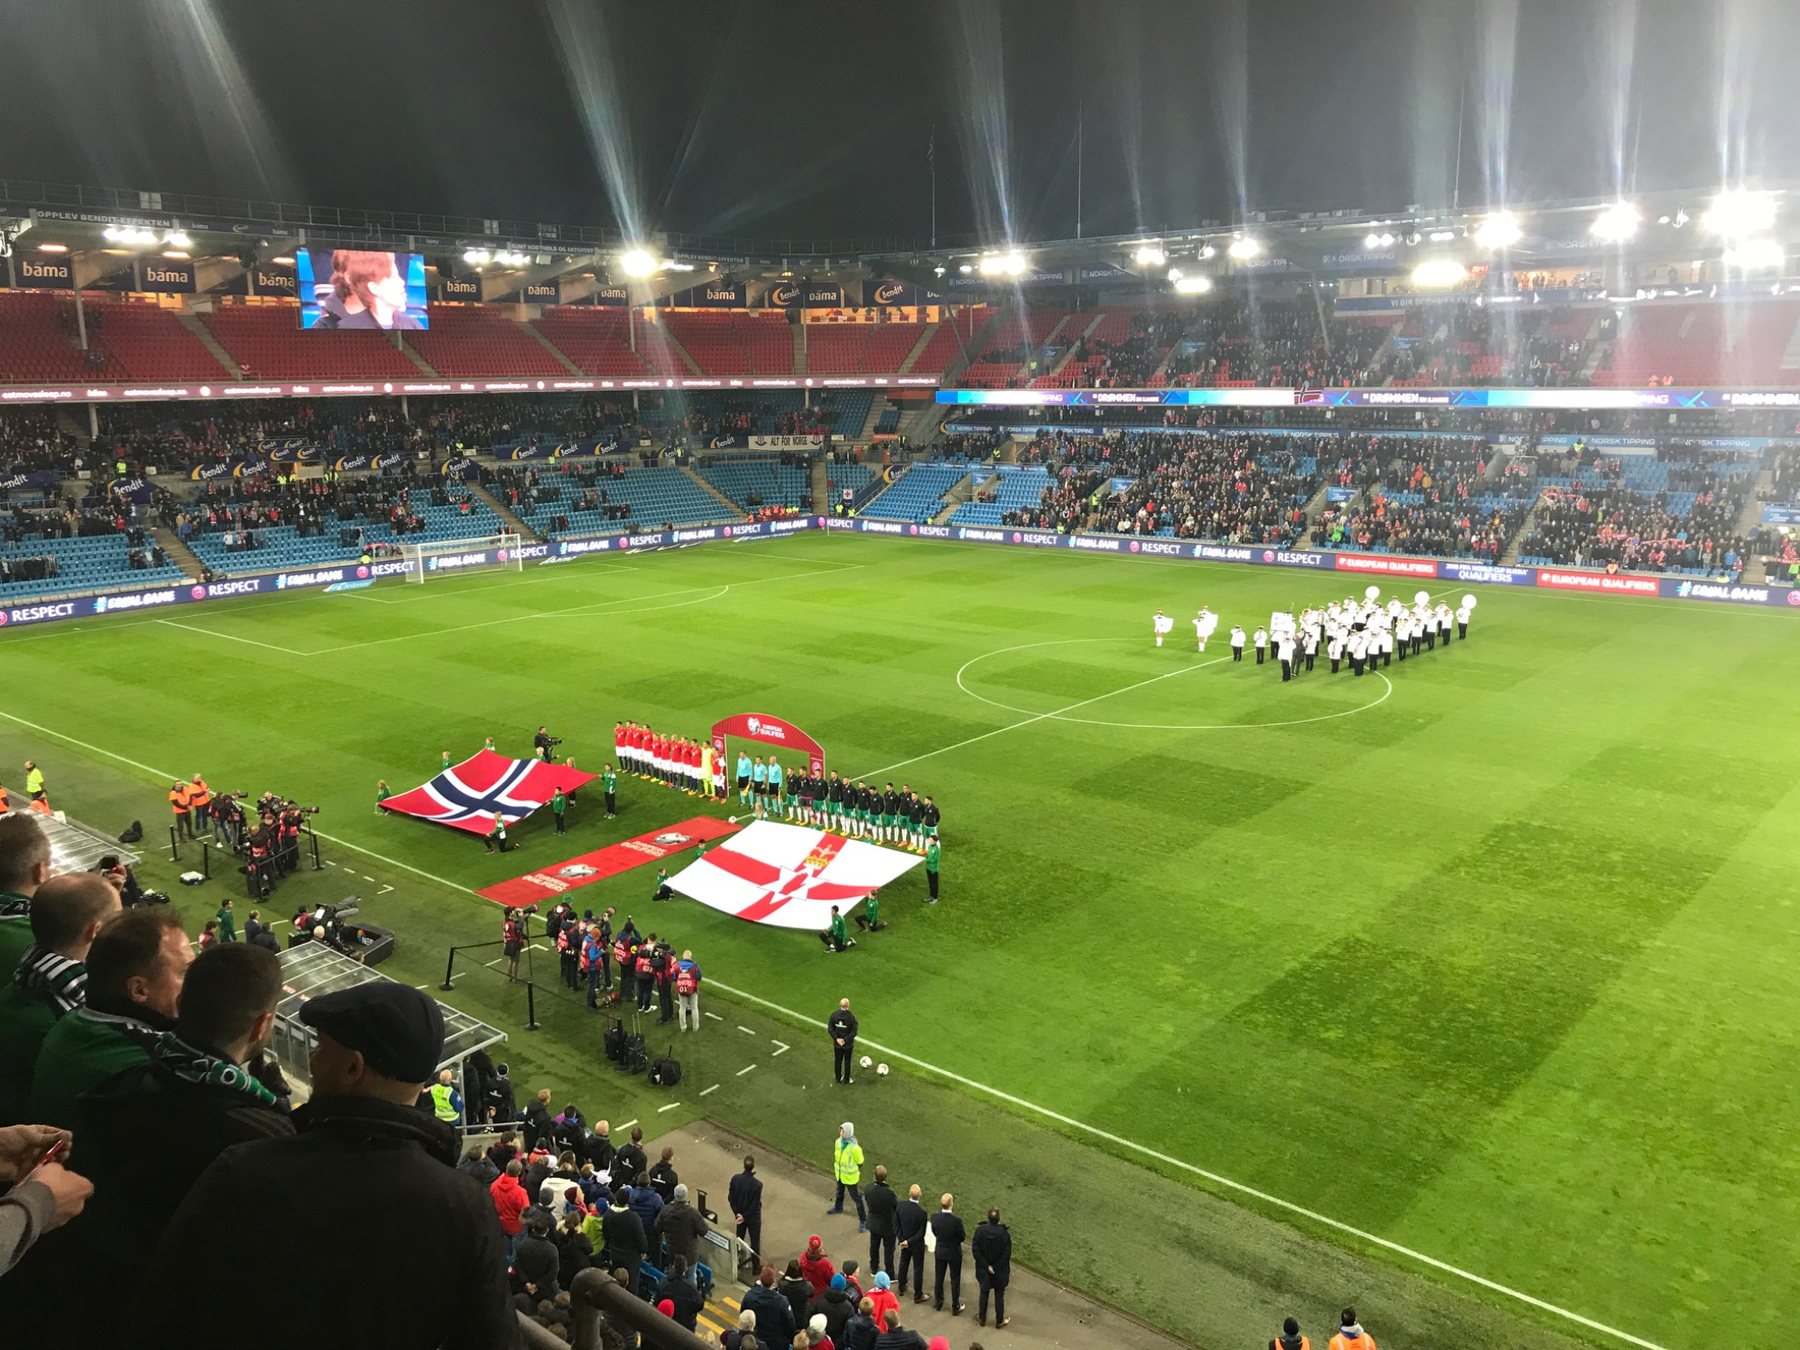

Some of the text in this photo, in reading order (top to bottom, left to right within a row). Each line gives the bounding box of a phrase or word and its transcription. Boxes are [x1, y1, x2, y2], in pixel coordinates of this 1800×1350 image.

[38, 210, 78, 220] OPPLEV
[23, 261, 68, 278] bama
[147, 268, 188, 282] bama
[259, 272, 294, 286] bama
[447, 281, 476, 293] bama
[780, 287, 800, 300] Bendit
[882, 285, 904, 298] Bendit
[707, 288, 736, 300] bama
[601, 441, 618, 454] Bendit
[716, 436, 735, 448] Bendit
[770, 436, 808, 446] ALT FOR NORGE
[518, 446, 538, 459] Bendit
[560, 443, 578, 456] Bendit
[343, 455, 366, 470] Bendit
[379, 454, 400, 468] Bendit
[449, 458, 471, 471] Bendit
[201, 463, 227, 479] Bendit
[242, 460, 268, 476] Bendit
[0, 474, 28, 488] endit
[114, 478, 144, 495] Bendit
[733, 524, 761, 536] RESPECT
[919, 526, 950, 537] RESPECT
[630, 534, 662, 546] RESPECT
[1023, 534, 1057, 545] RESPECT
[510, 546, 548, 559] RESPECT
[1142, 542, 1181, 554] RESPECT
[1278, 552, 1322, 565] RESPECT
[372, 562, 415, 576] RESPECT
[1347, 559, 1434, 574] EUROPEAN QUALIFIERS
[1459, 571, 1512, 582] QUALIFIERS
[1552, 574, 1656, 591] EUROPEAN QUALIFIERS
[208, 579, 259, 597] RESPECT
[12, 603, 74, 622] RESPECT
[761, 728, 785, 739] QUALIFIERS
